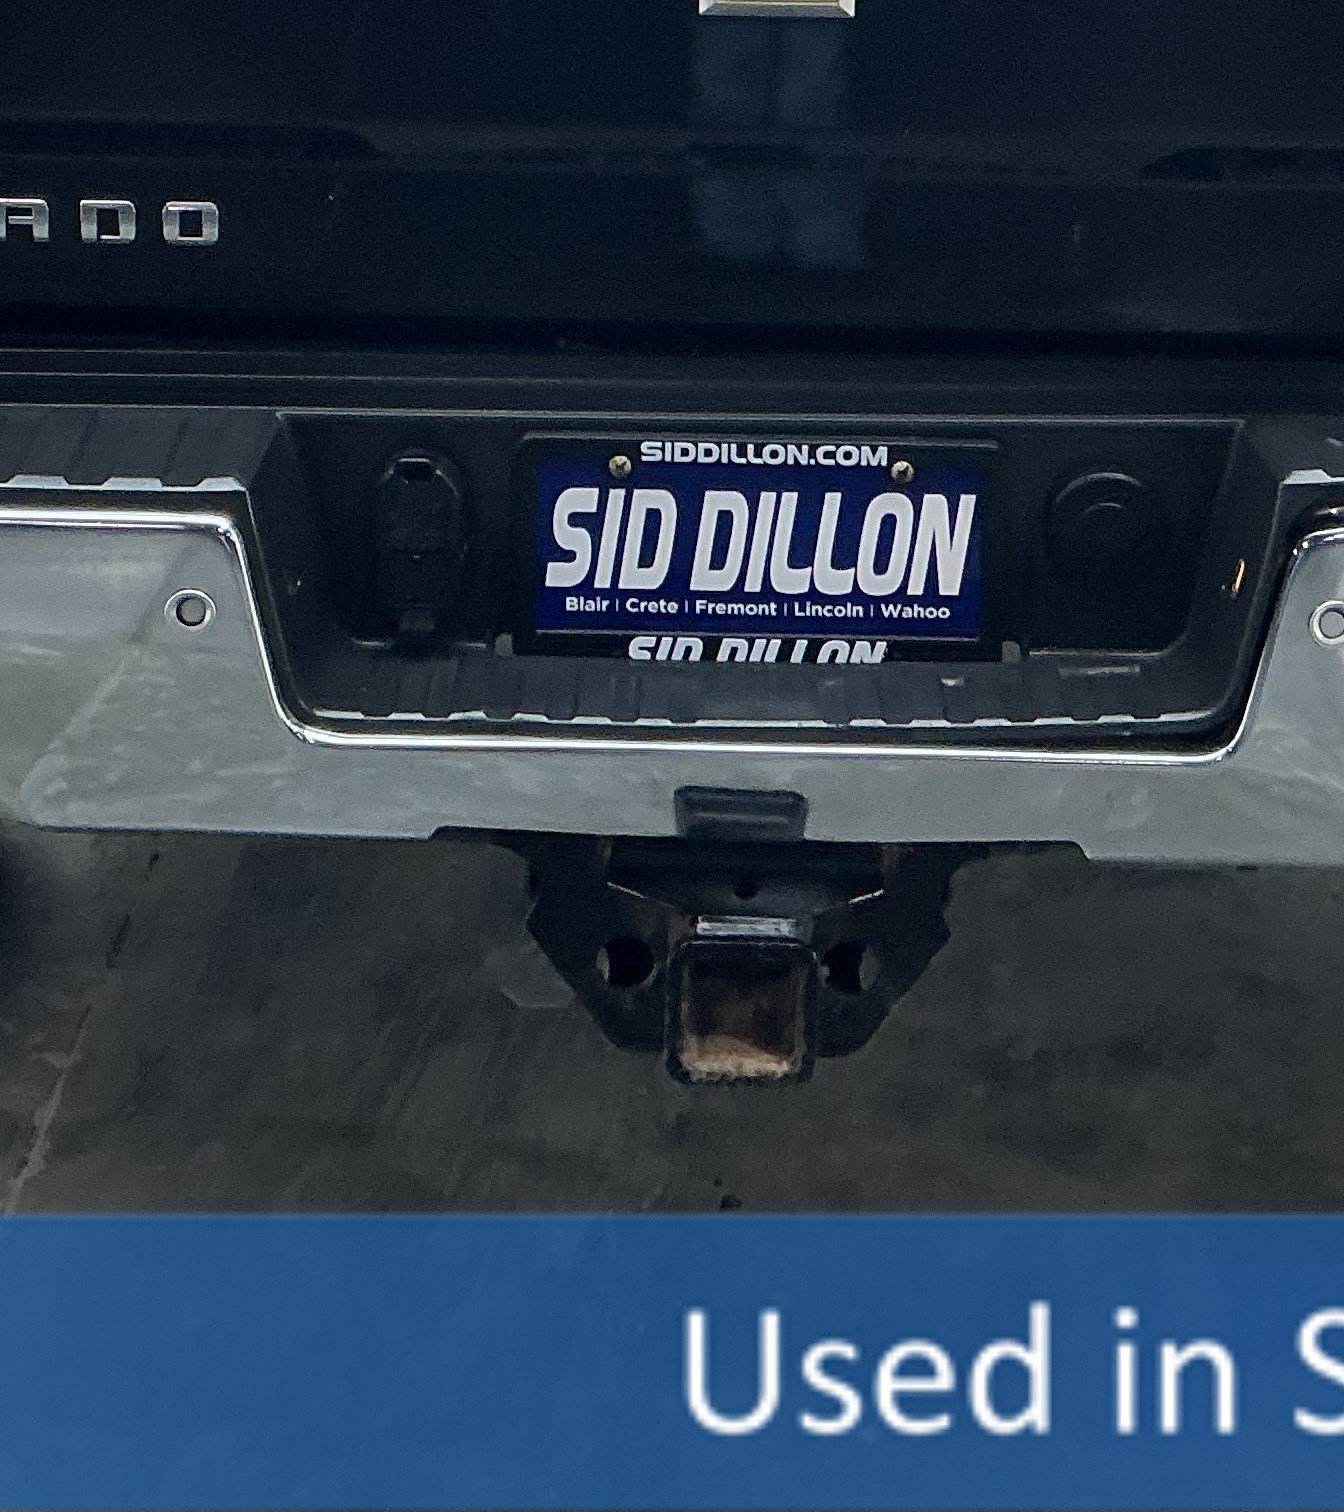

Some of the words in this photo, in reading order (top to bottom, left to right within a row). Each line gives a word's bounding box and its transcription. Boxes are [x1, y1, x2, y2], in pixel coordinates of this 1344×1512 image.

[640, 440, 888, 467] SIDDILLON.COM
[545, 487, 677, 590] SID
[689, 490, 977, 596] DILLON
[565, 596, 610, 613] Blair
[625, 598, 679, 615] Crete
[695, 599, 777, 617] Fremont
[794, 601, 864, 619] Lincoln
[881, 603, 950, 620] Wahoo
